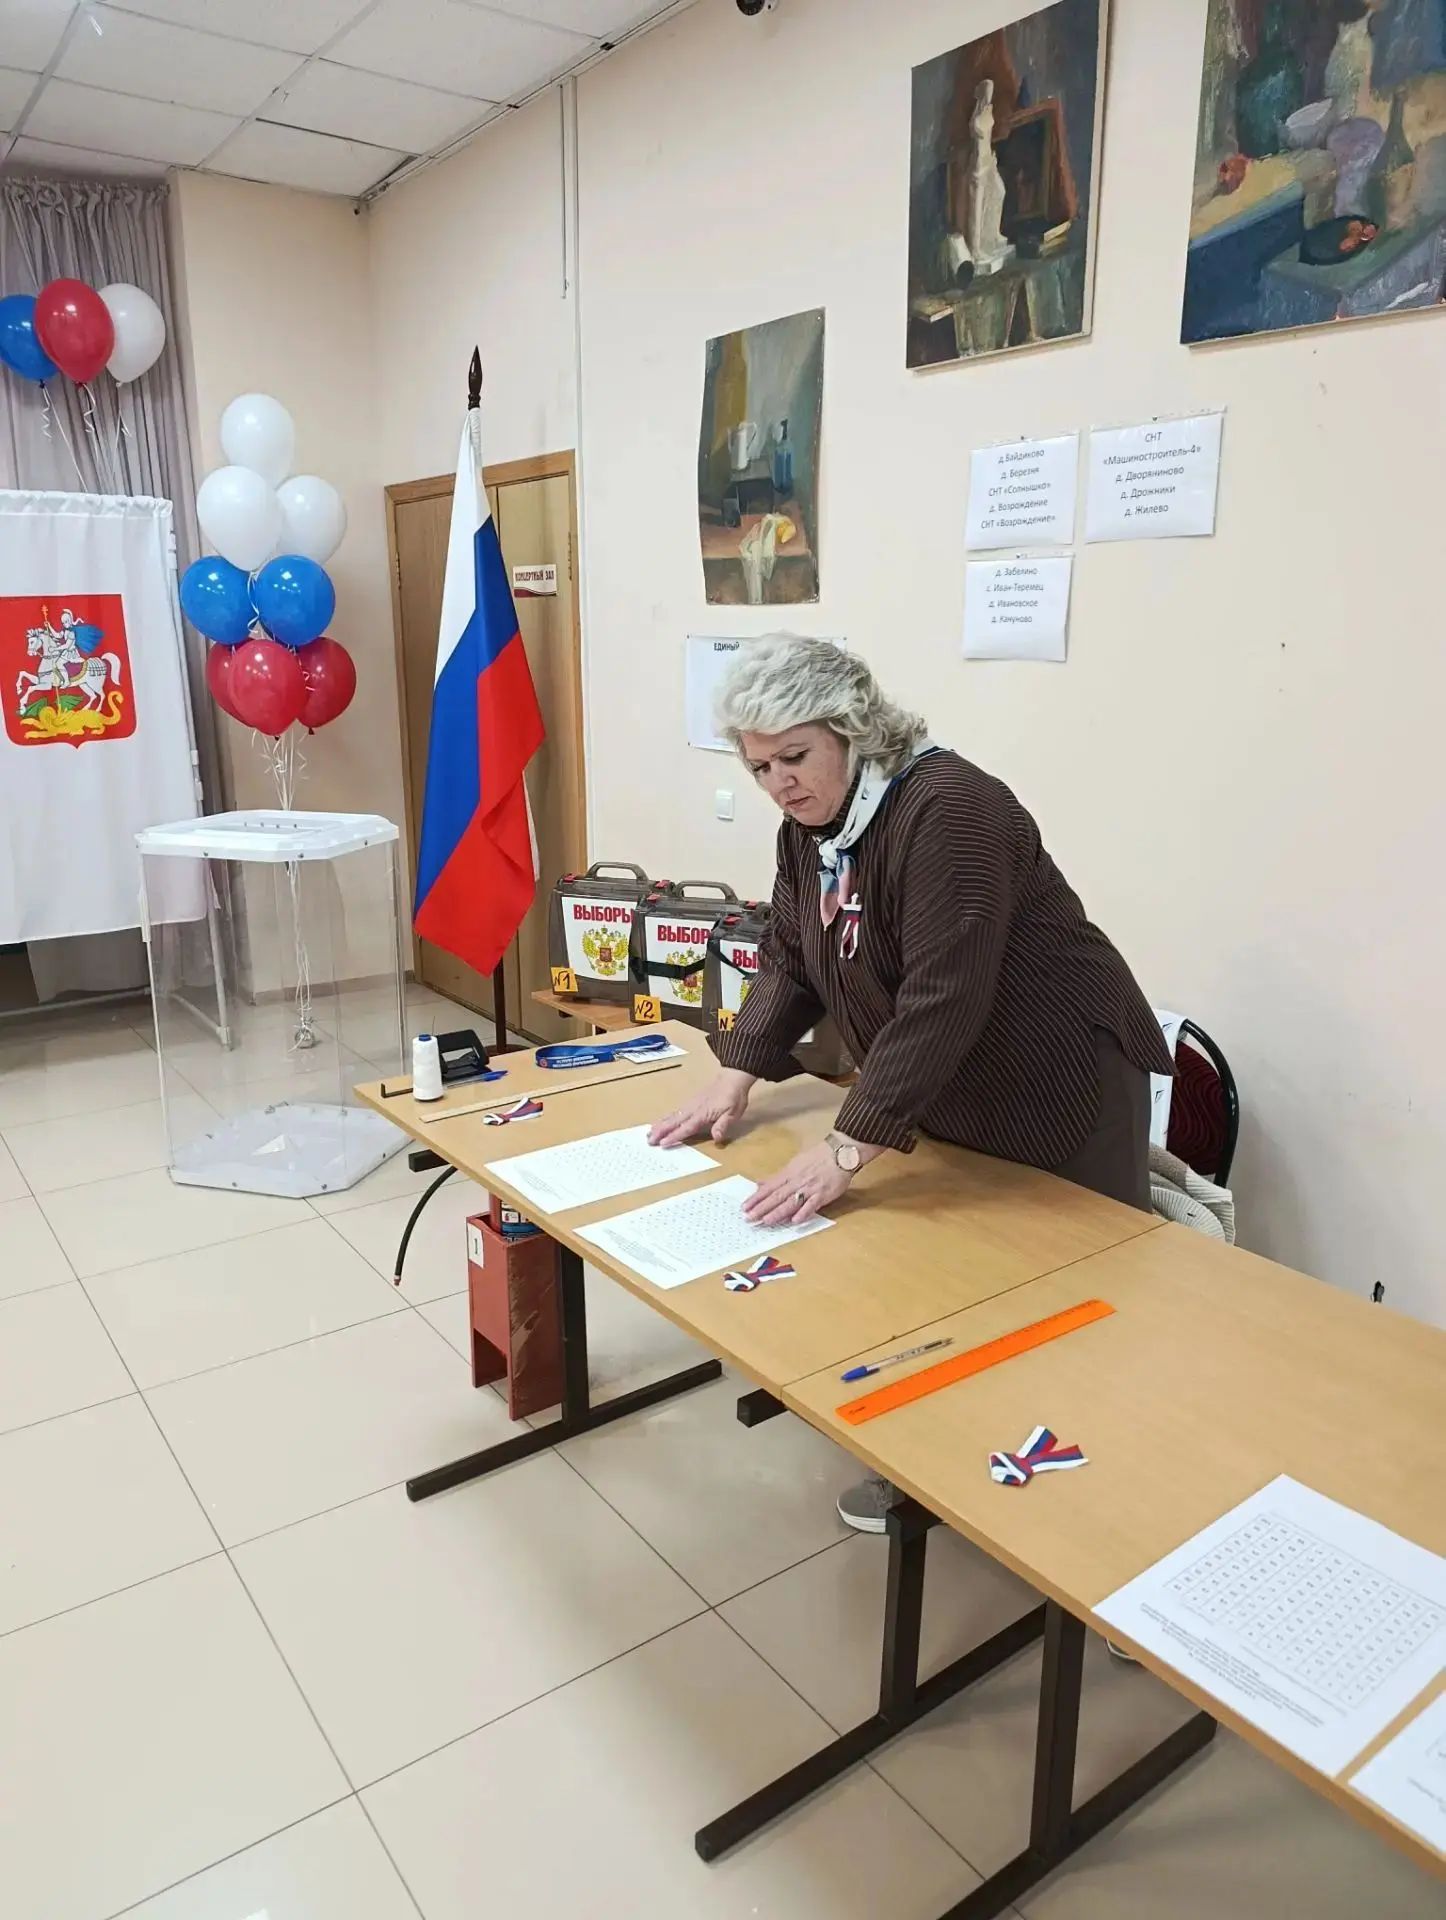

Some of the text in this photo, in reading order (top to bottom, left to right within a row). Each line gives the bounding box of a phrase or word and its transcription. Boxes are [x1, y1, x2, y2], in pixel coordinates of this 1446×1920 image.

[1145, 431, 1162, 442] СНТ
[1103, 444, 1202, 465] «Машиностроитель-4»
[1125, 466, 1184, 482] Дворяниново
[988, 486, 1003, 497] СНТ
[1130, 486, 1176, 499] Дрожники
[1135, 504, 1169, 515] Жилево
[981, 519, 994, 529] СНТ
[545, 570, 554, 580] ЗАЛ
[714, 641, 740, 652] ЕДИНЫЙ
[657, 925, 711, 944] ВЫБОР
[733, 948, 759, 969] ВЫ
